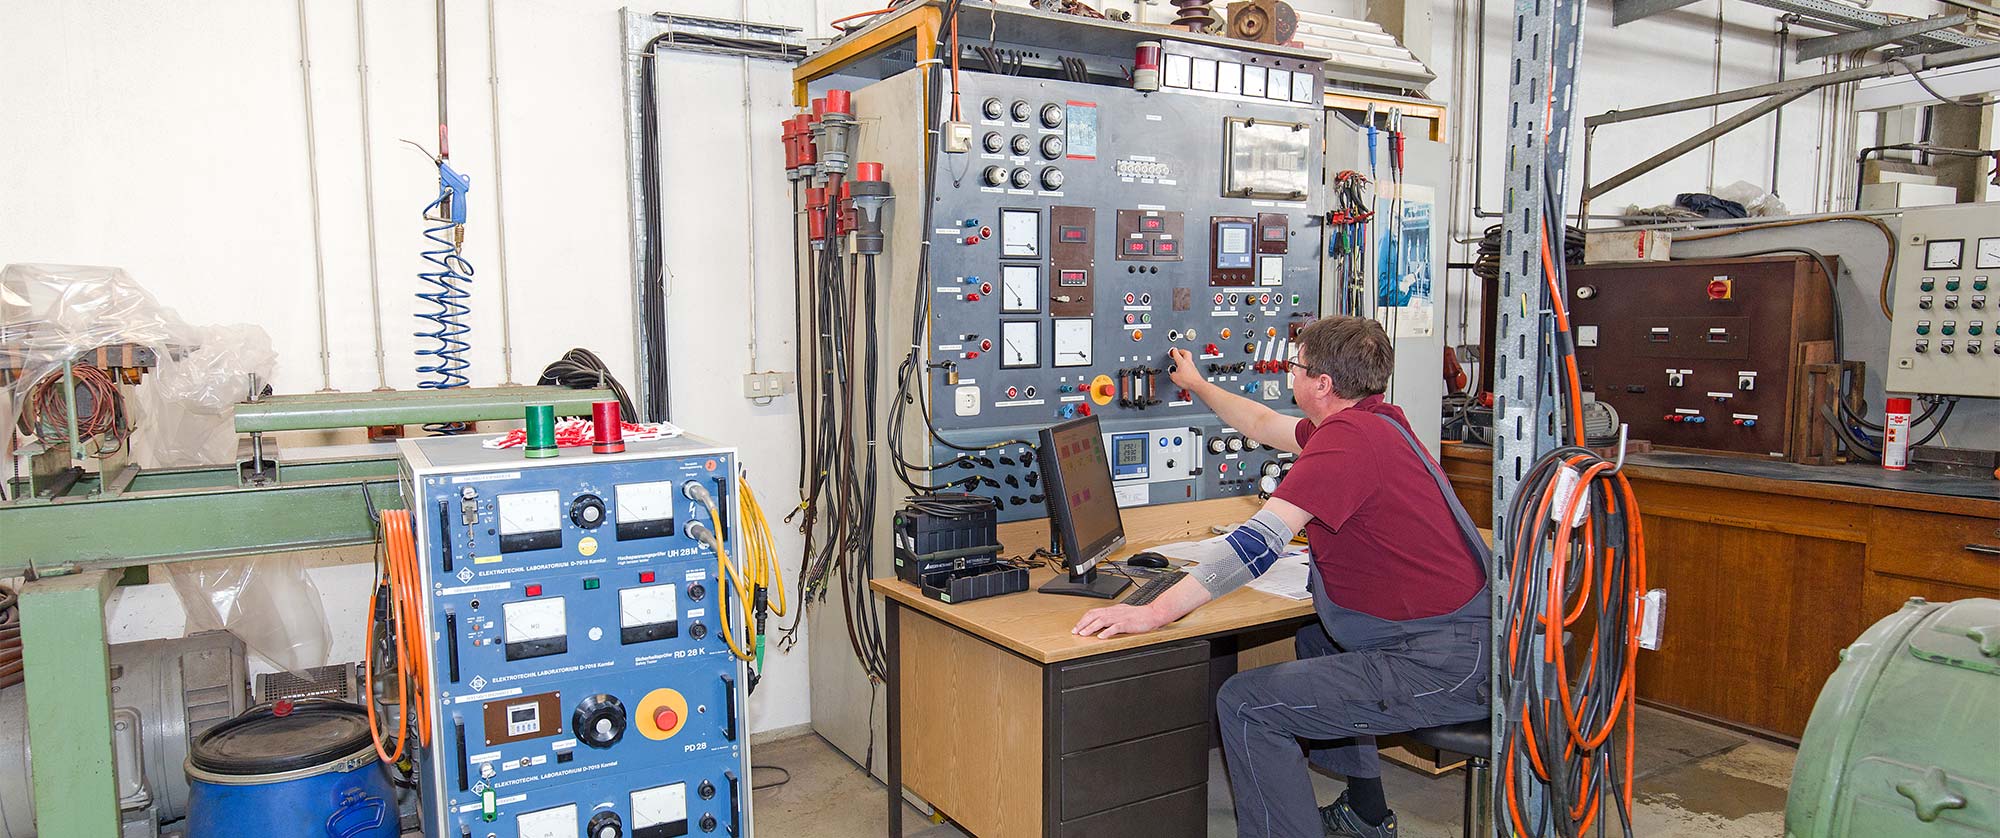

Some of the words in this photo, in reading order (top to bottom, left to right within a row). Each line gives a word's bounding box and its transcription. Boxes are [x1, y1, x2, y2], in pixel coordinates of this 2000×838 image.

[667, 550, 679, 558] UH
[526, 562, 569, 573] LABORATORIUM
[674, 650, 686, 659] RD
[687, 649, 698, 657] 28
[699, 647, 706, 655] K
[537, 665, 579, 678] LABORATORIUM
[684, 744, 696, 753] PD
[540, 767, 582, 780] LABORATORIUM
